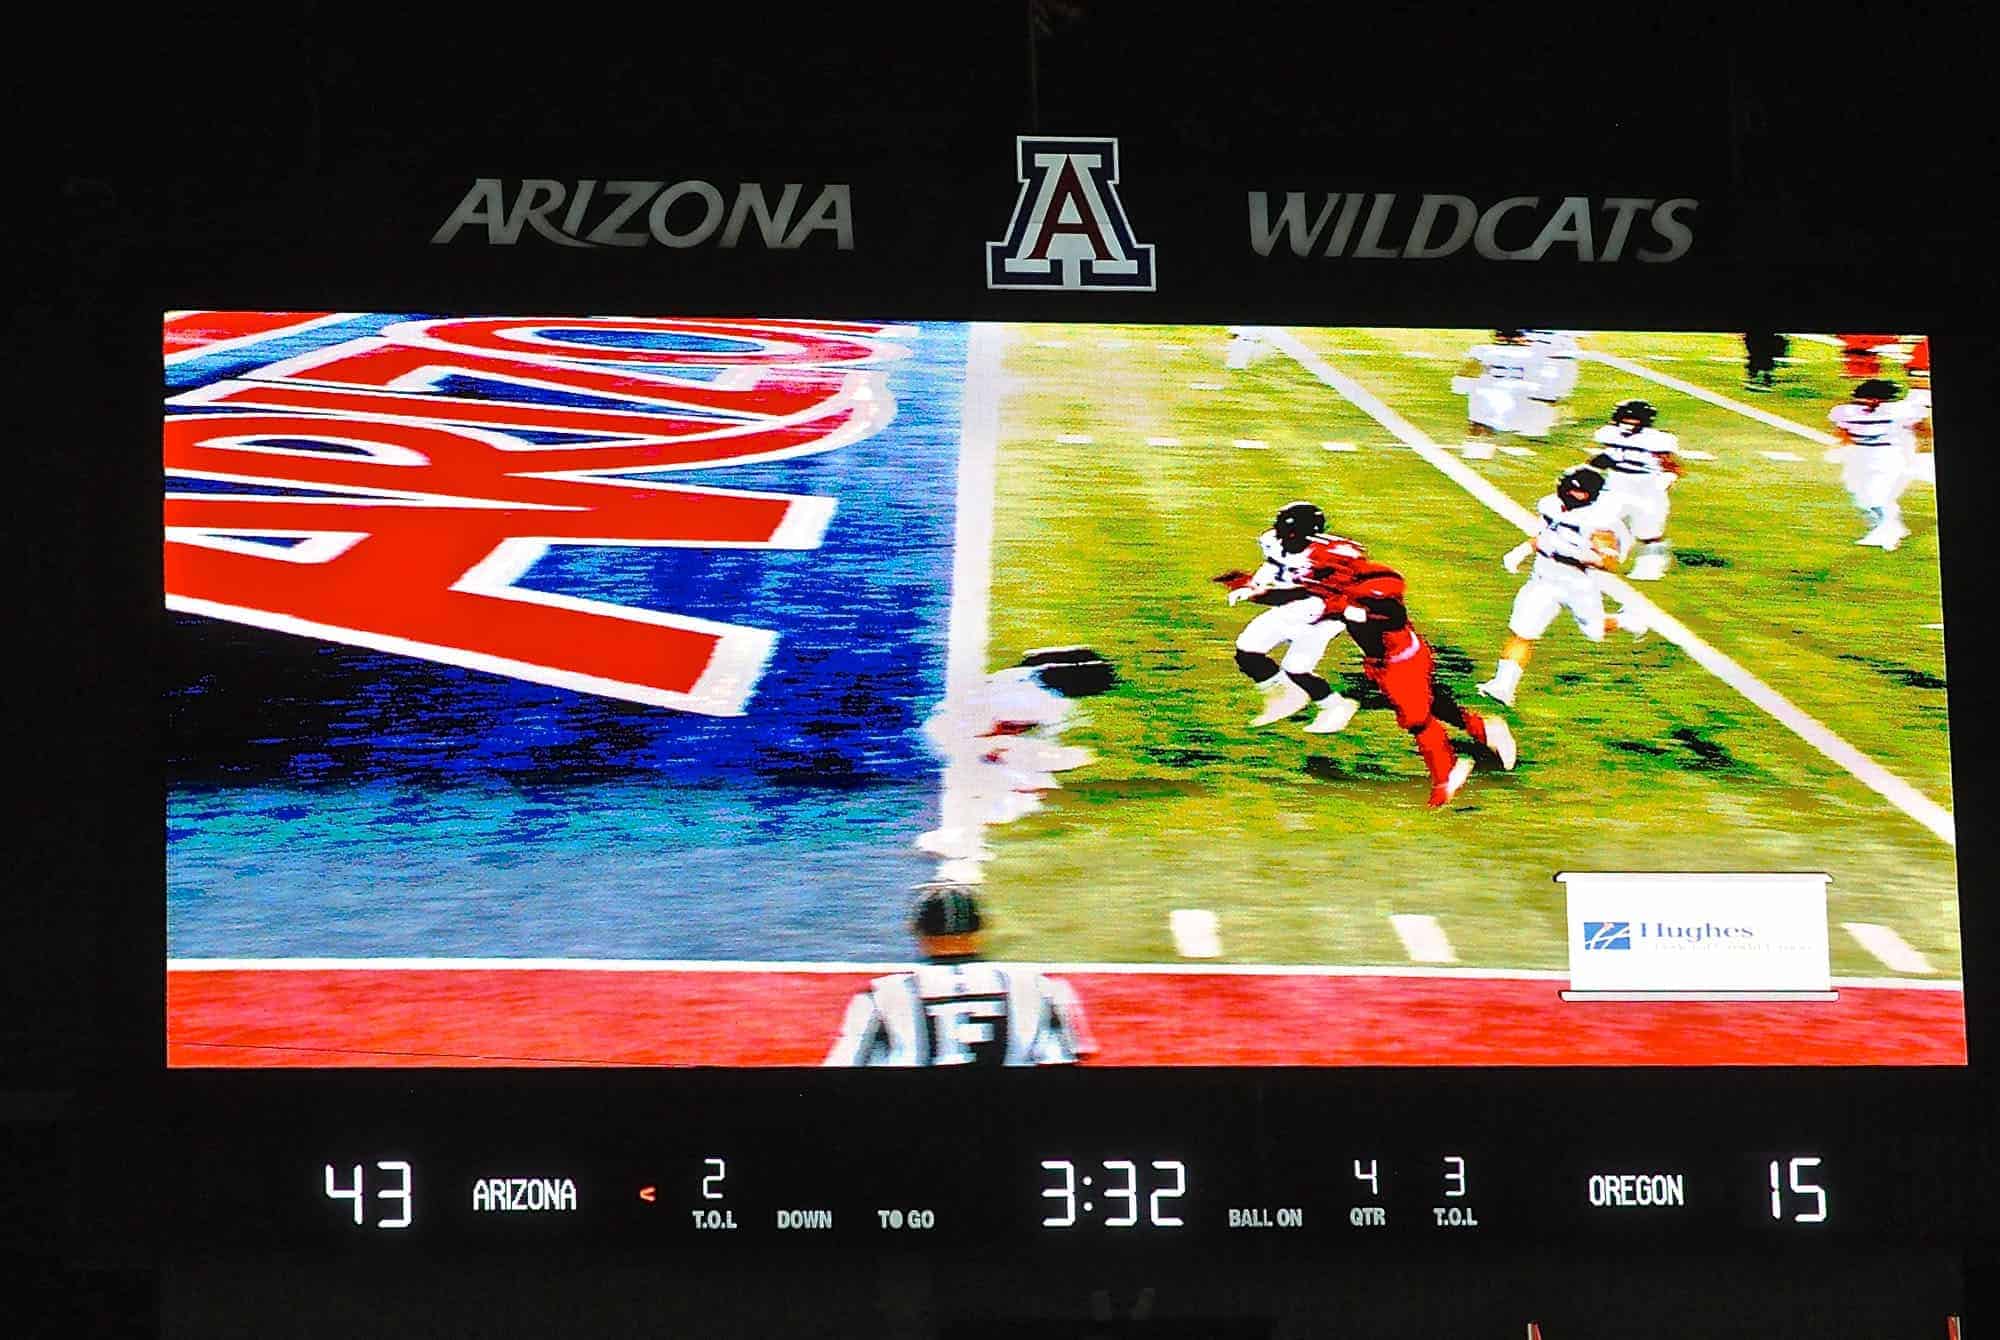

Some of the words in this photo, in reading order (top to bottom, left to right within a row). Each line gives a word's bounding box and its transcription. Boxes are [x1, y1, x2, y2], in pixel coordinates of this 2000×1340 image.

[434, 179, 854, 248] ARIZONA
[986, 135, 1158, 292] A
[1247, 191, 1699, 262] WILDCATS
[1640, 922, 1754, 943] Hughes
[703, 1158, 726, 1199] 2
[1041, 1160, 1186, 1227] 3:32
[1354, 1159, 1378, 1195] 4
[1444, 1157, 1466, 1196] 3
[1589, 1175, 1685, 1207] OREGON
[1770, 1158, 1828, 1223] 15
[325, 1160, 413, 1228] 43
[473, 1179, 576, 1211] ARIZONA
[692, 1210, 738, 1229] T.O.L
[777, 1210, 833, 1229] DOWN
[878, 1210, 904, 1229] TO
[908, 1210, 935, 1229] GO
[1228, 1209, 1274, 1228] BALL
[1277, 1208, 1303, 1227] ON
[1350, 1208, 1386, 1228] QTR
[1433, 1208, 1479, 1227] T.O.L
